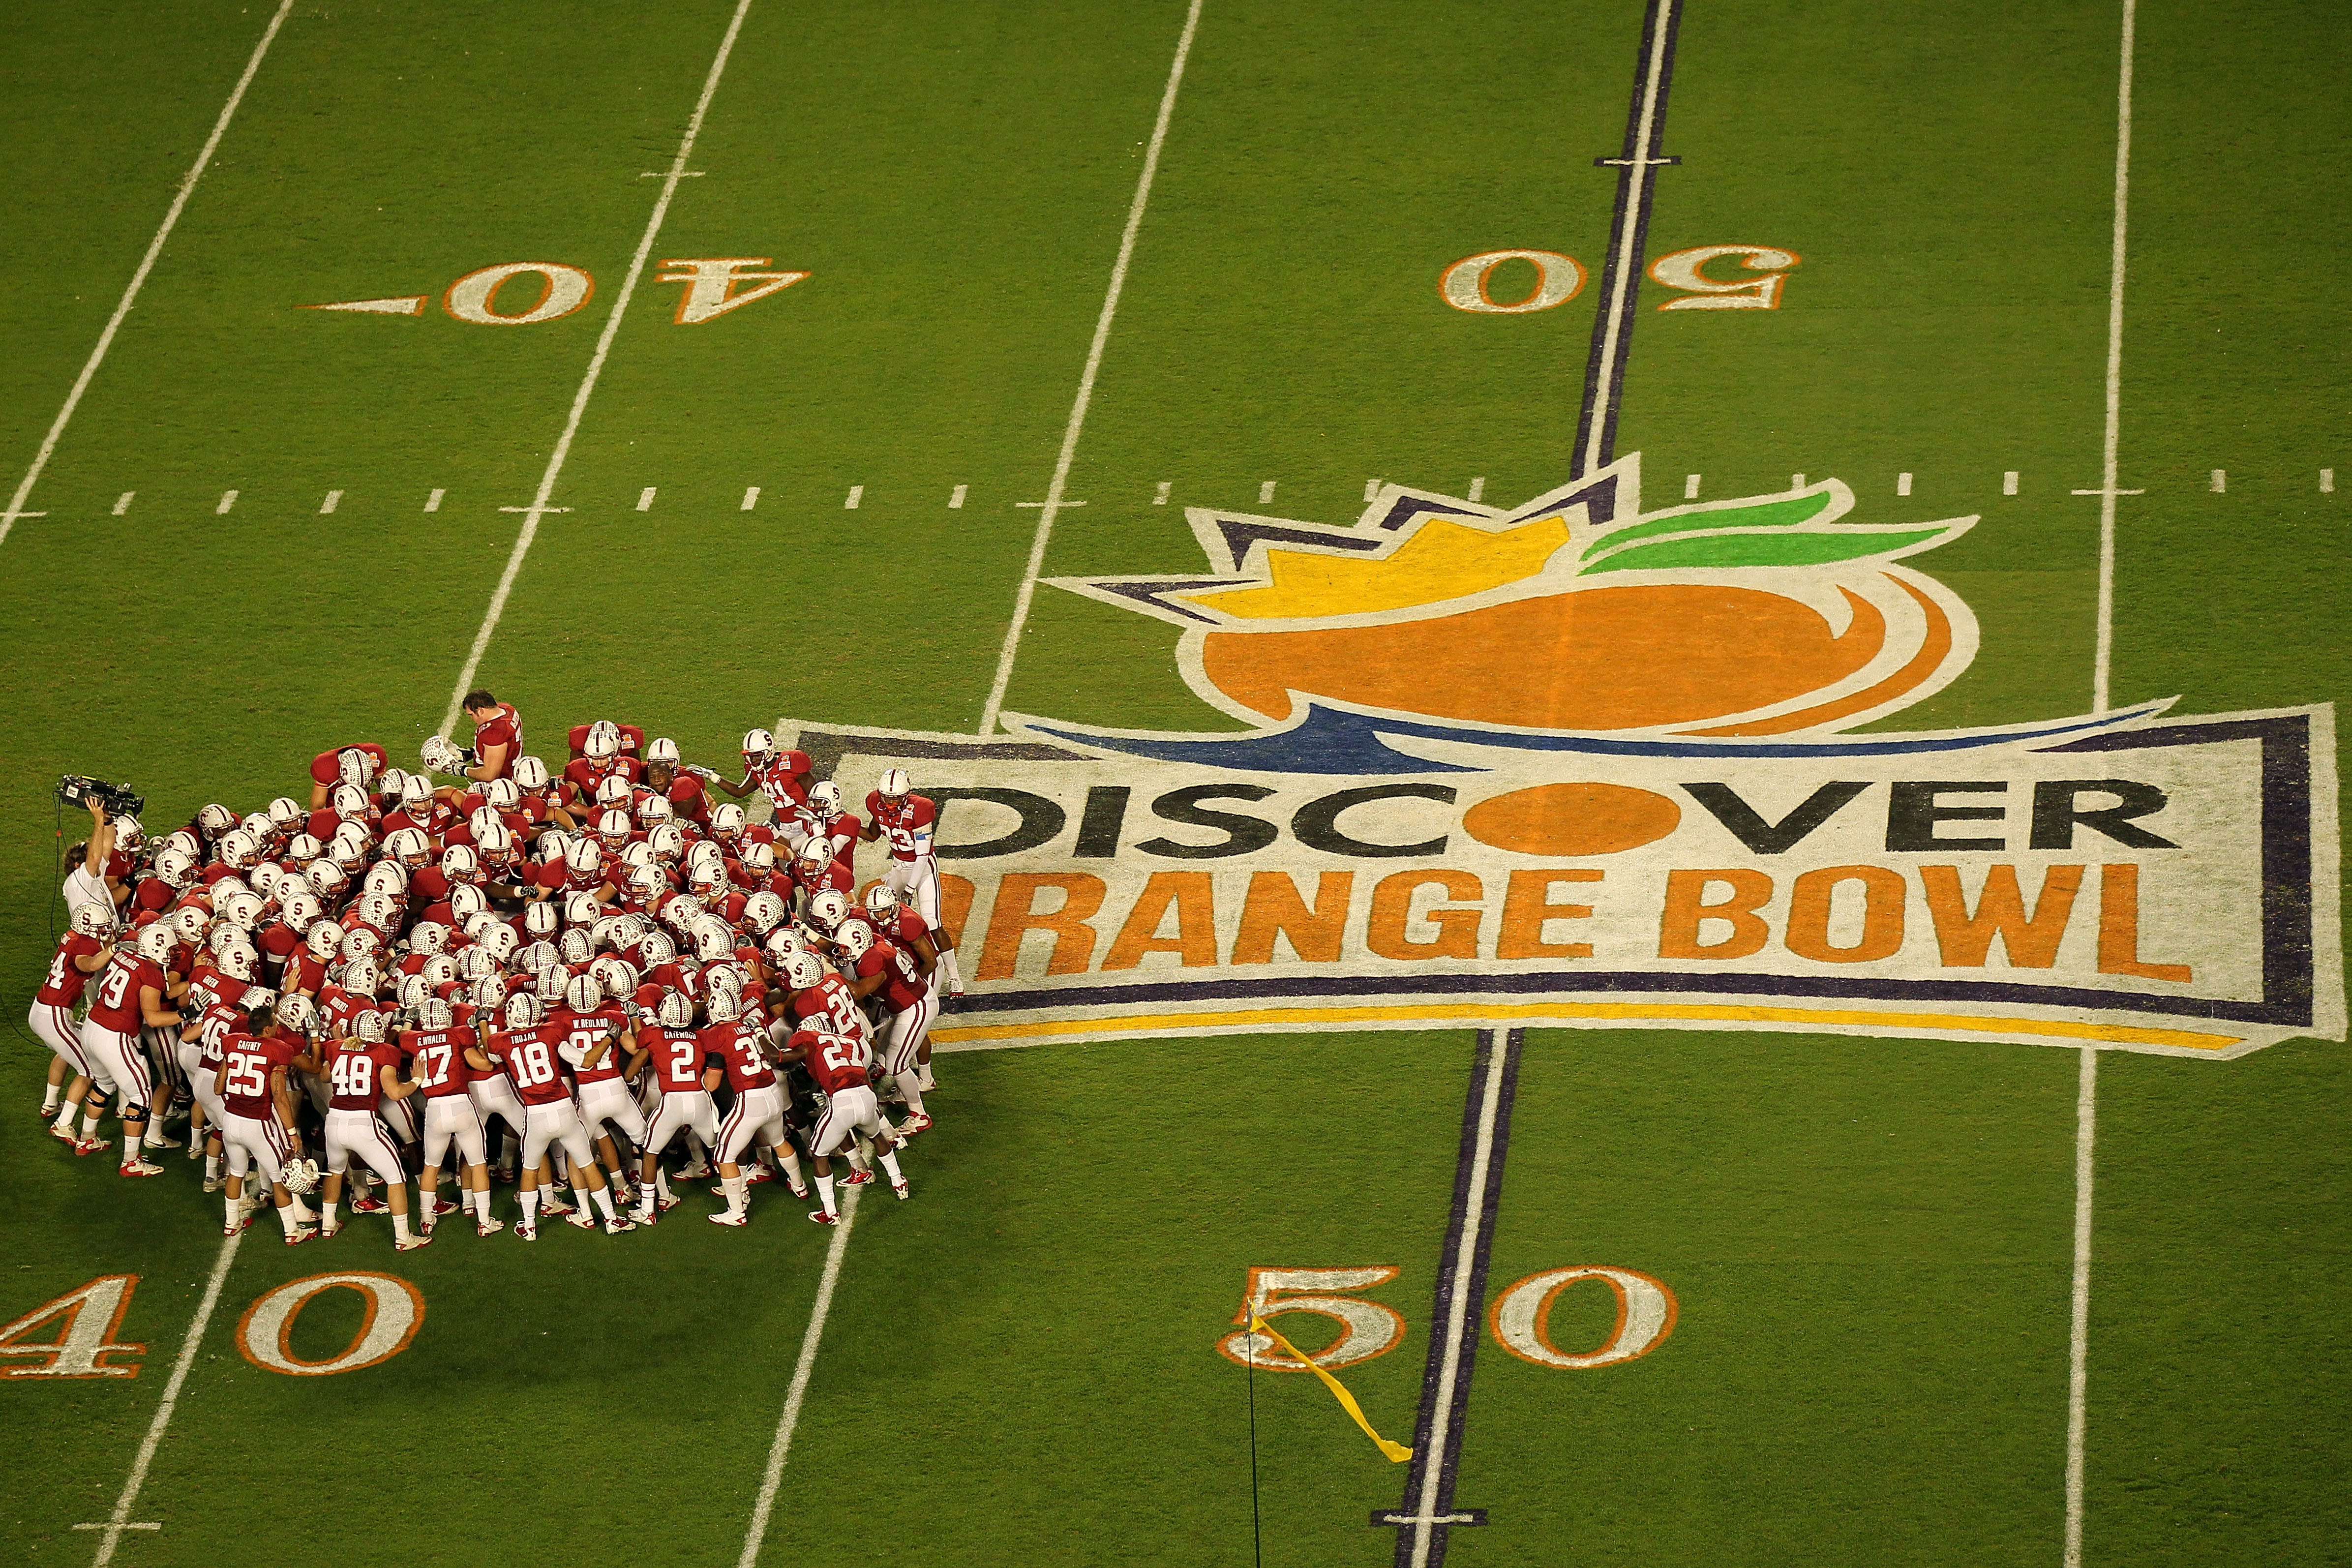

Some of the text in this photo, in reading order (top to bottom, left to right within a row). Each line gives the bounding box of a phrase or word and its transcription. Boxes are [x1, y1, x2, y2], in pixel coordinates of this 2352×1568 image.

[1437, 244, 1801, 314] 50
[764, 734, 772, 746] S
[833, 787, 840, 799] S
[338, 795, 344, 806] S
[887, 779, 2182, 859] DISCOVER
[228, 841, 235, 853] S
[822, 845, 829, 858] S
[446, 850, 453, 862] S
[165, 860, 173, 874] S
[262, 874, 271, 886] S
[313, 872, 321, 885] S
[713, 869, 722, 881] S
[281, 882, 289, 895] S
[376, 879, 385, 891] S
[455, 894, 462, 906] S
[238, 906, 247, 918] S
[295, 903, 303, 915] S
[374, 901, 383, 913] S
[587, 903, 596, 915] S
[675, 905, 684, 917] S
[759, 904, 767, 917] S
[827, 904, 836, 915] S
[82, 912, 90, 926] S
[185, 915, 193, 927] S
[1658, 864, 2192, 983] BOWL
[322, 931, 331, 944] S
[429, 931, 437, 943] S
[615, 925, 622, 937] S
[852, 931, 861, 944] S
[156, 934, 165, 946] S
[354, 938, 362, 950] S
[501, 933, 509, 945] S
[702, 934, 709, 946] S
[646, 941, 653, 954] S
[784, 940, 792, 953] S
[234, 951, 243, 964] S
[46, 951, 66, 990] 4
[442, 965, 450, 978] S
[794, 963, 803, 975] S
[97, 961, 130, 1009] 79
[421, 982, 428, 995] S
[713, 976, 722, 989] S
[496, 984, 504, 996] S
[290, 1003, 300, 1016] S
[827, 984, 860, 1034] 28
[374, 1017, 382, 1029] S
[573, 1018, 608, 1029] W.REULAND
[417, 1034, 446, 1046] G.WHALEN
[511, 1031, 537, 1045] TROJAN
[664, 1031, 696, 1040] GATEWOOD
[237, 1040, 262, 1052] GAFFNEY
[817, 1035, 864, 1071] 27
[419, 1044, 452, 1088] 17
[510, 1041, 554, 1088] 18
[670, 1041, 695, 1082] 2
[226, 1052, 267, 1097] 25
[331, 1055, 373, 1096] 48
[0, 1270, 426, 1379] 40
[1215, 1264, 1679, 1372] 50
